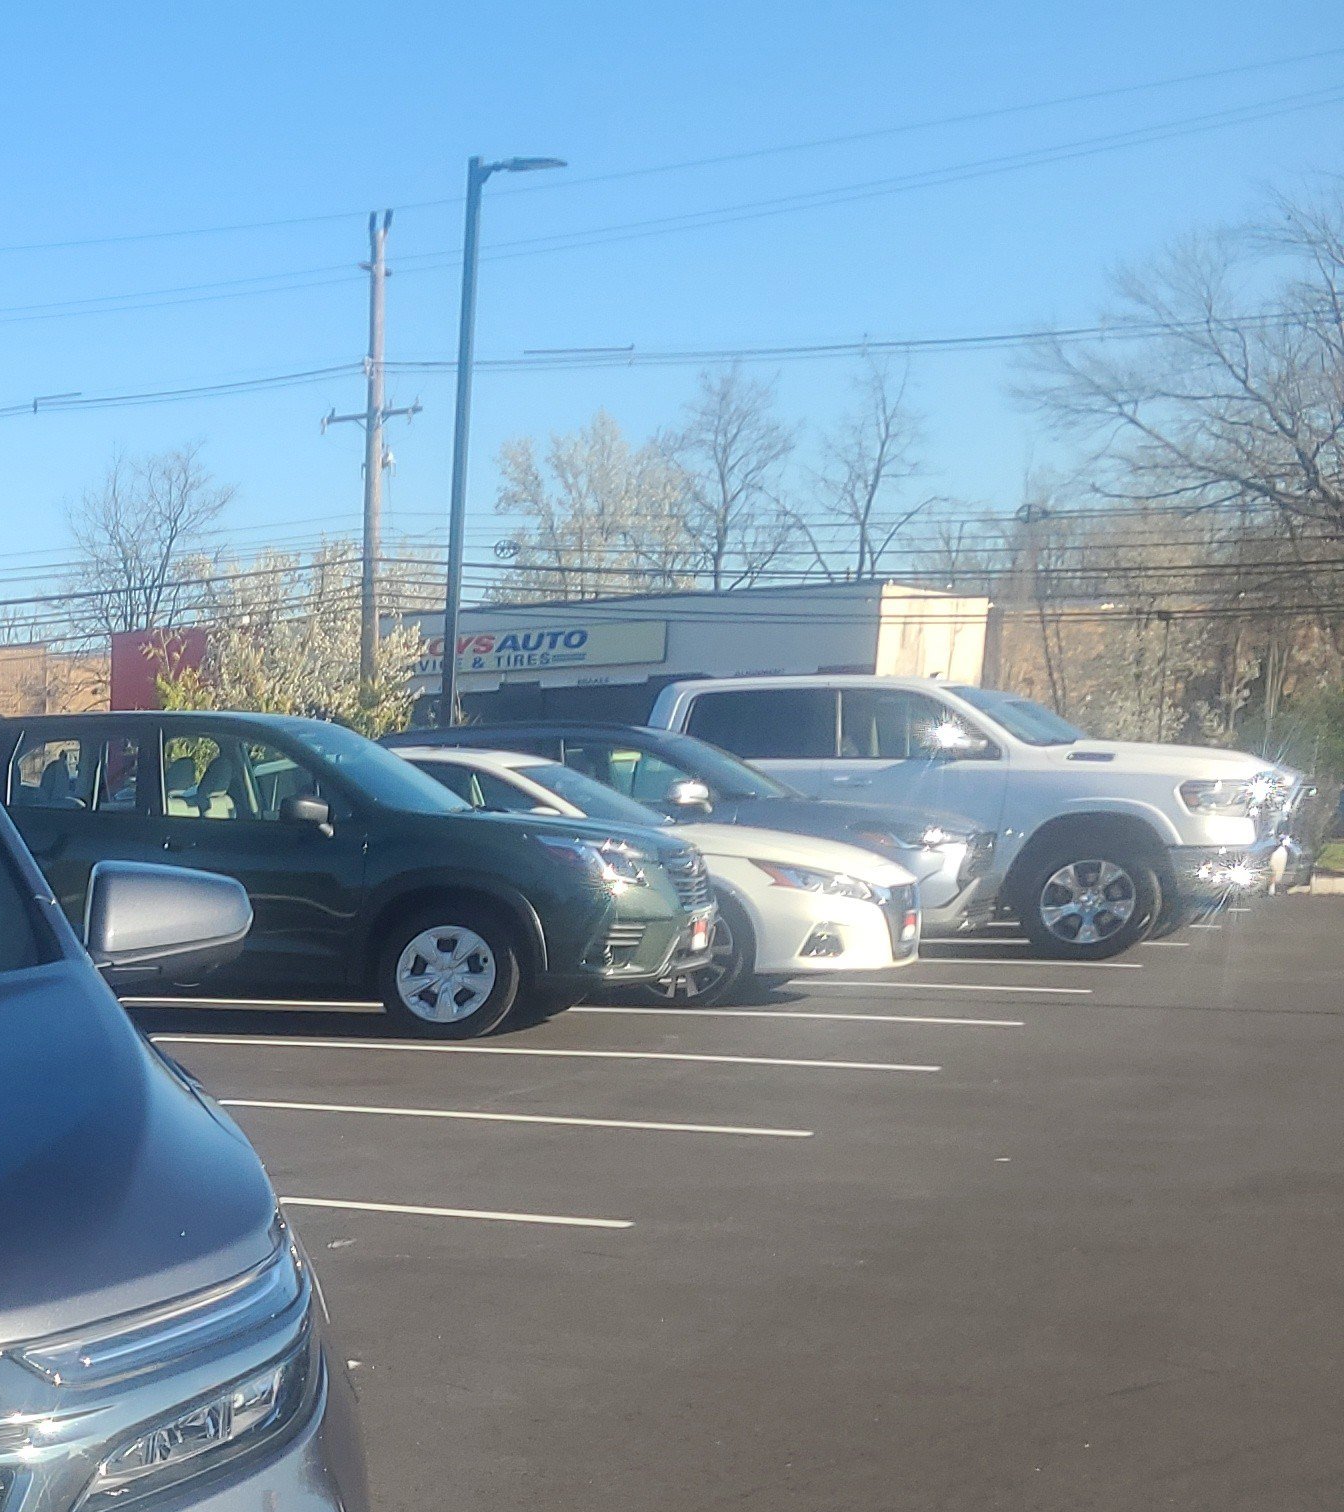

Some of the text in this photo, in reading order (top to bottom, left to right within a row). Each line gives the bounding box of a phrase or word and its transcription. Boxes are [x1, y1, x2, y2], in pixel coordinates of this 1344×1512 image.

[494, 629, 588, 653] AUTO
[472, 656, 485, 669] &
[494, 652, 551, 668] TIRES
